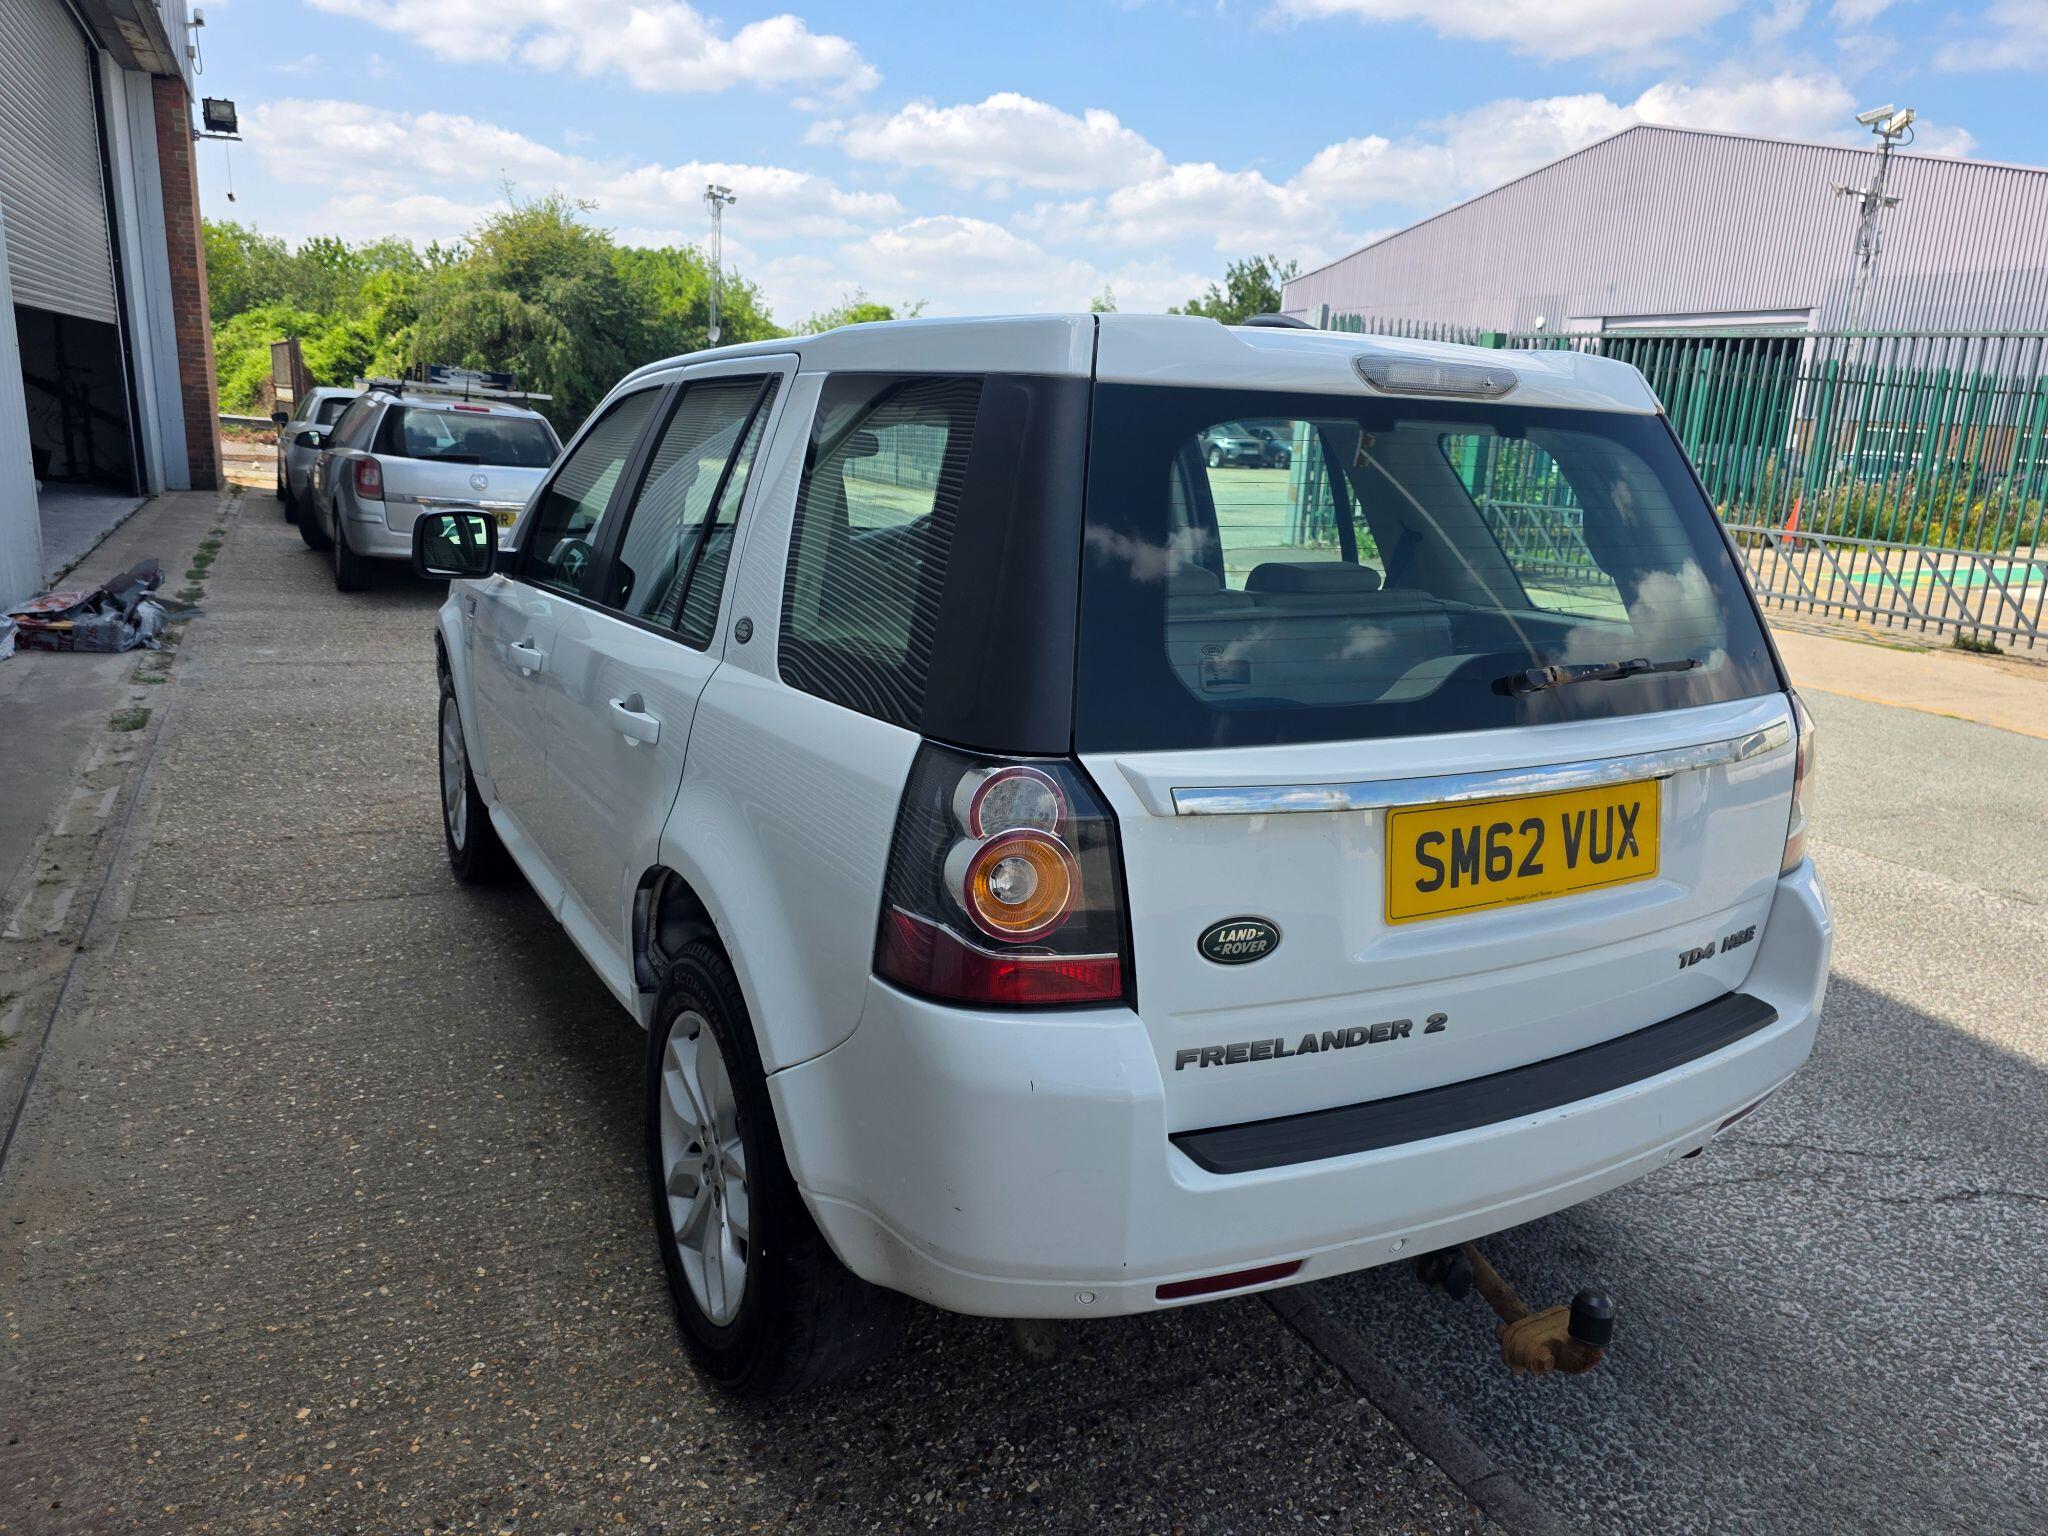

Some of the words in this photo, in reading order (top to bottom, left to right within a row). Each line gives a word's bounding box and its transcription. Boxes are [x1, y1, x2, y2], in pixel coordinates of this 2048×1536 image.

[1414, 817, 1546, 893] SM62
[1561, 802, 1641, 869] VUX
[1219, 928, 1257, 942] LAND
[1221, 940, 1267, 955] ROVER
[1679, 941, 1716, 969] TD4
[1721, 924, 1757, 953] HSE
[1175, 1018, 1413, 1071] FREELANDER
[1424, 1012, 1448, 1035] 2
